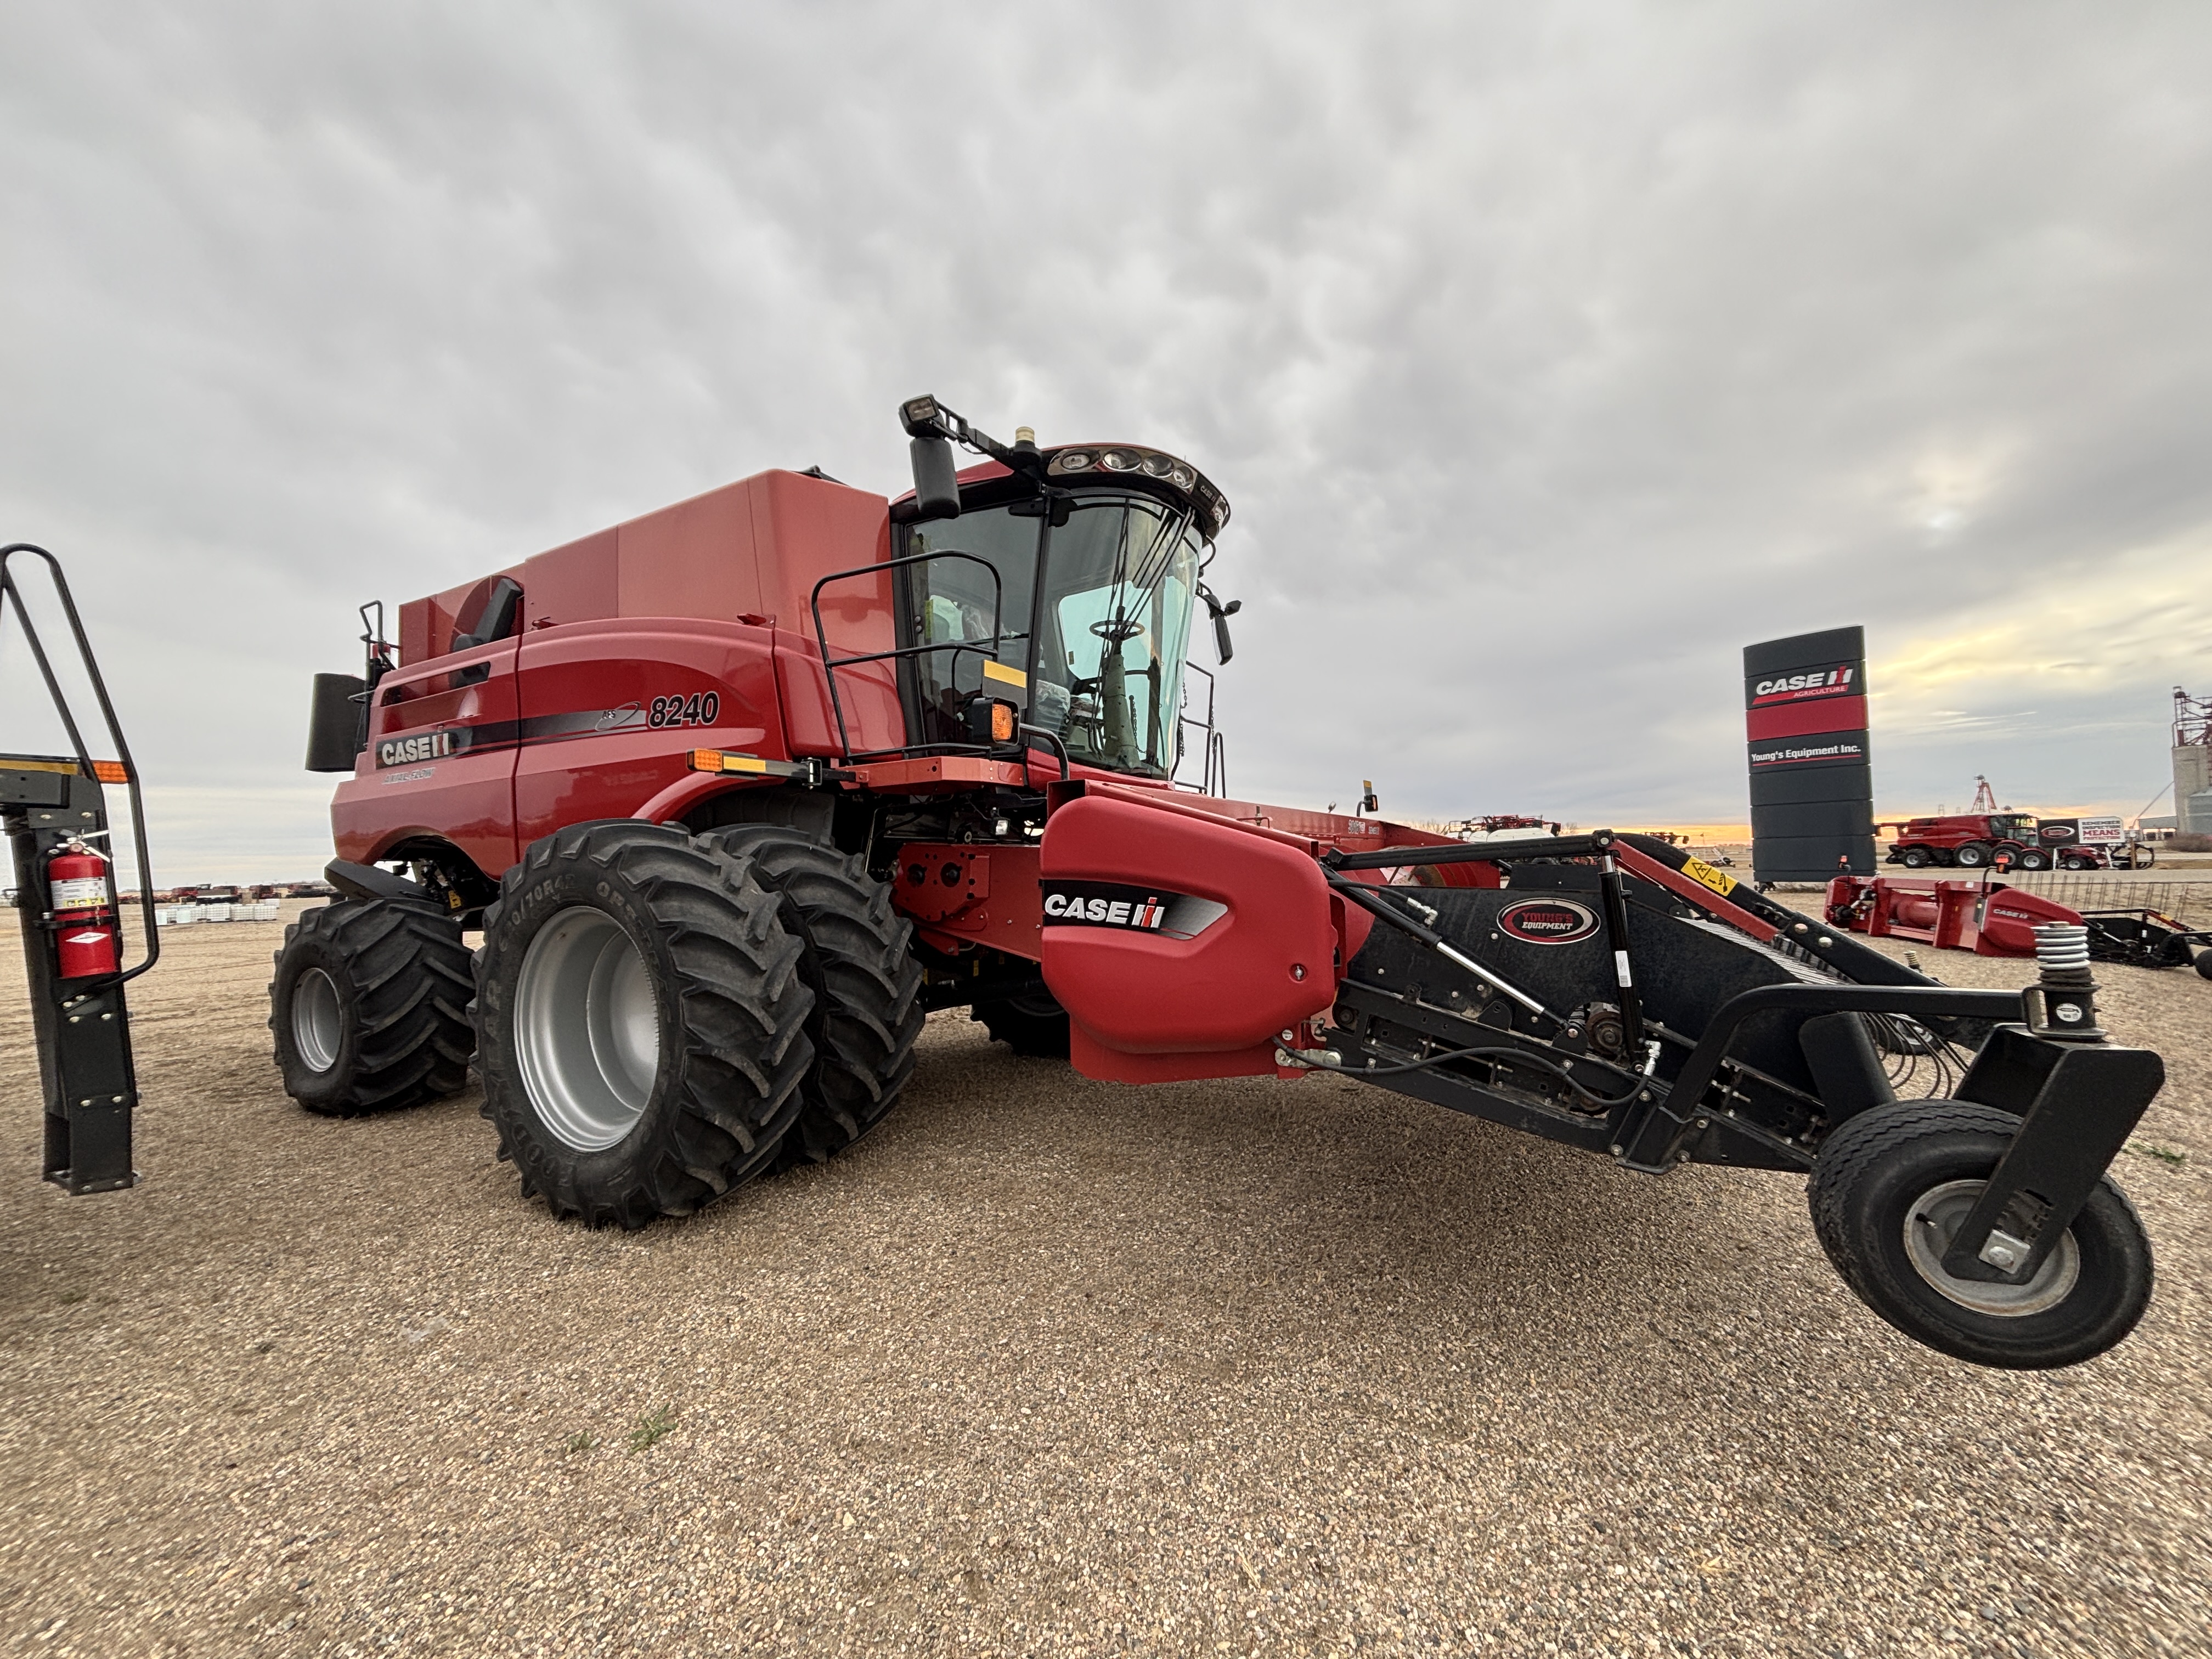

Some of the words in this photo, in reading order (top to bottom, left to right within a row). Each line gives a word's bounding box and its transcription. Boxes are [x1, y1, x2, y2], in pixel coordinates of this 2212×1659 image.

[1756, 673, 1825, 695] CASE
[1793, 686, 1846, 697] AGRICULTURE
[602, 710, 617, 719] AFS
[648, 691, 720, 729] 8240
[382, 736, 431, 765] CASE
[1751, 751, 1784, 761] Young's
[1786, 745, 1838, 759] Equipment
[1841, 744, 1861, 753] Inc.
[1045, 894, 1132, 924] CASE
[1993, 909, 2019, 917] CASE
[1521, 912, 1575, 922] YOUNG'S
[1521, 922, 1573, 930] EQUIPMENT
